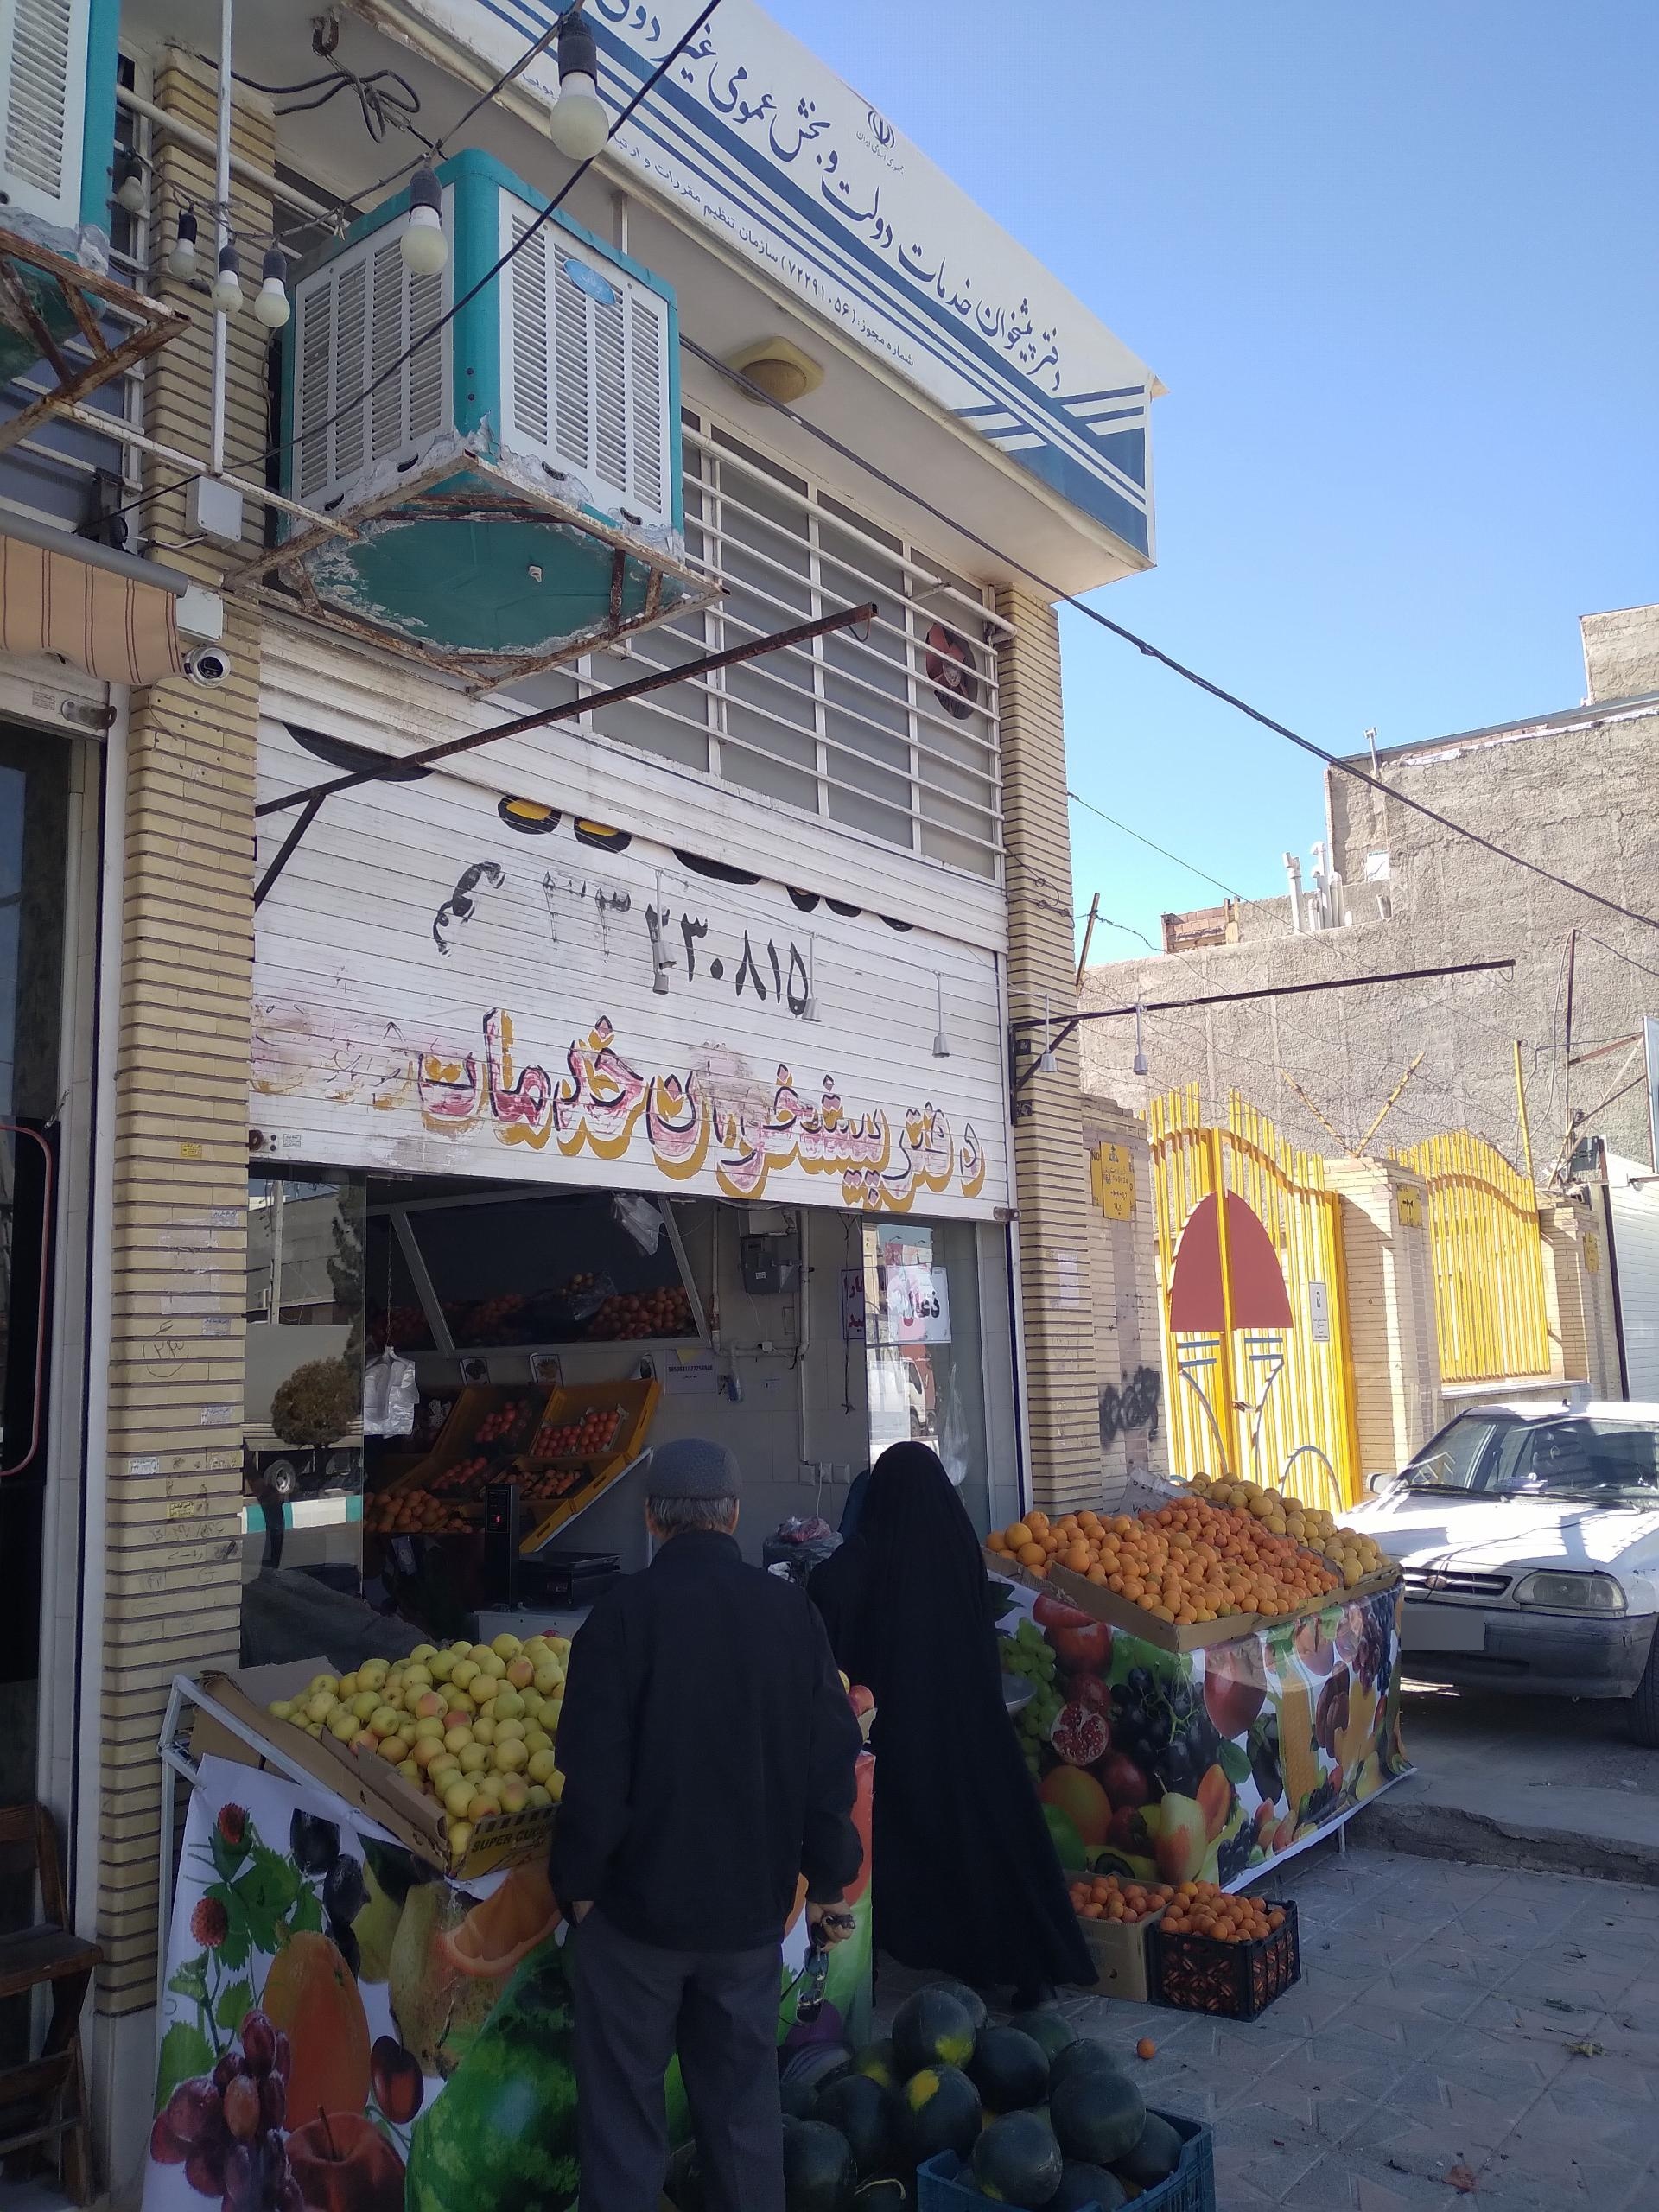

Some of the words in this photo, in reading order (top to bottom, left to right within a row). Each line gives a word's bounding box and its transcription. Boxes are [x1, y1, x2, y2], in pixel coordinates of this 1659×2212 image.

[649, 22, 717, 84] غیر
[707, 65, 778, 124] عمومی
[768, 96, 832, 168] بخش
[824, 149, 839, 174] و
[654, 164, 701, 203] مقررات
[821, 175, 893, 249] دولت
[702, 204, 736, 230] تنظیم
[739, 226, 779, 264] سازمان
[898, 243, 973, 316] خدمات
[887, 341, 915, 367] شماره
[976, 297, 1038, 363] پیشخوان
[1027, 327, 1061, 391] دفتر
[418, 1006, 648, 1161] خدمات
[878, 1100, 986, 1213] دفتر
[471, 1833, 513, 1853] SUPER
